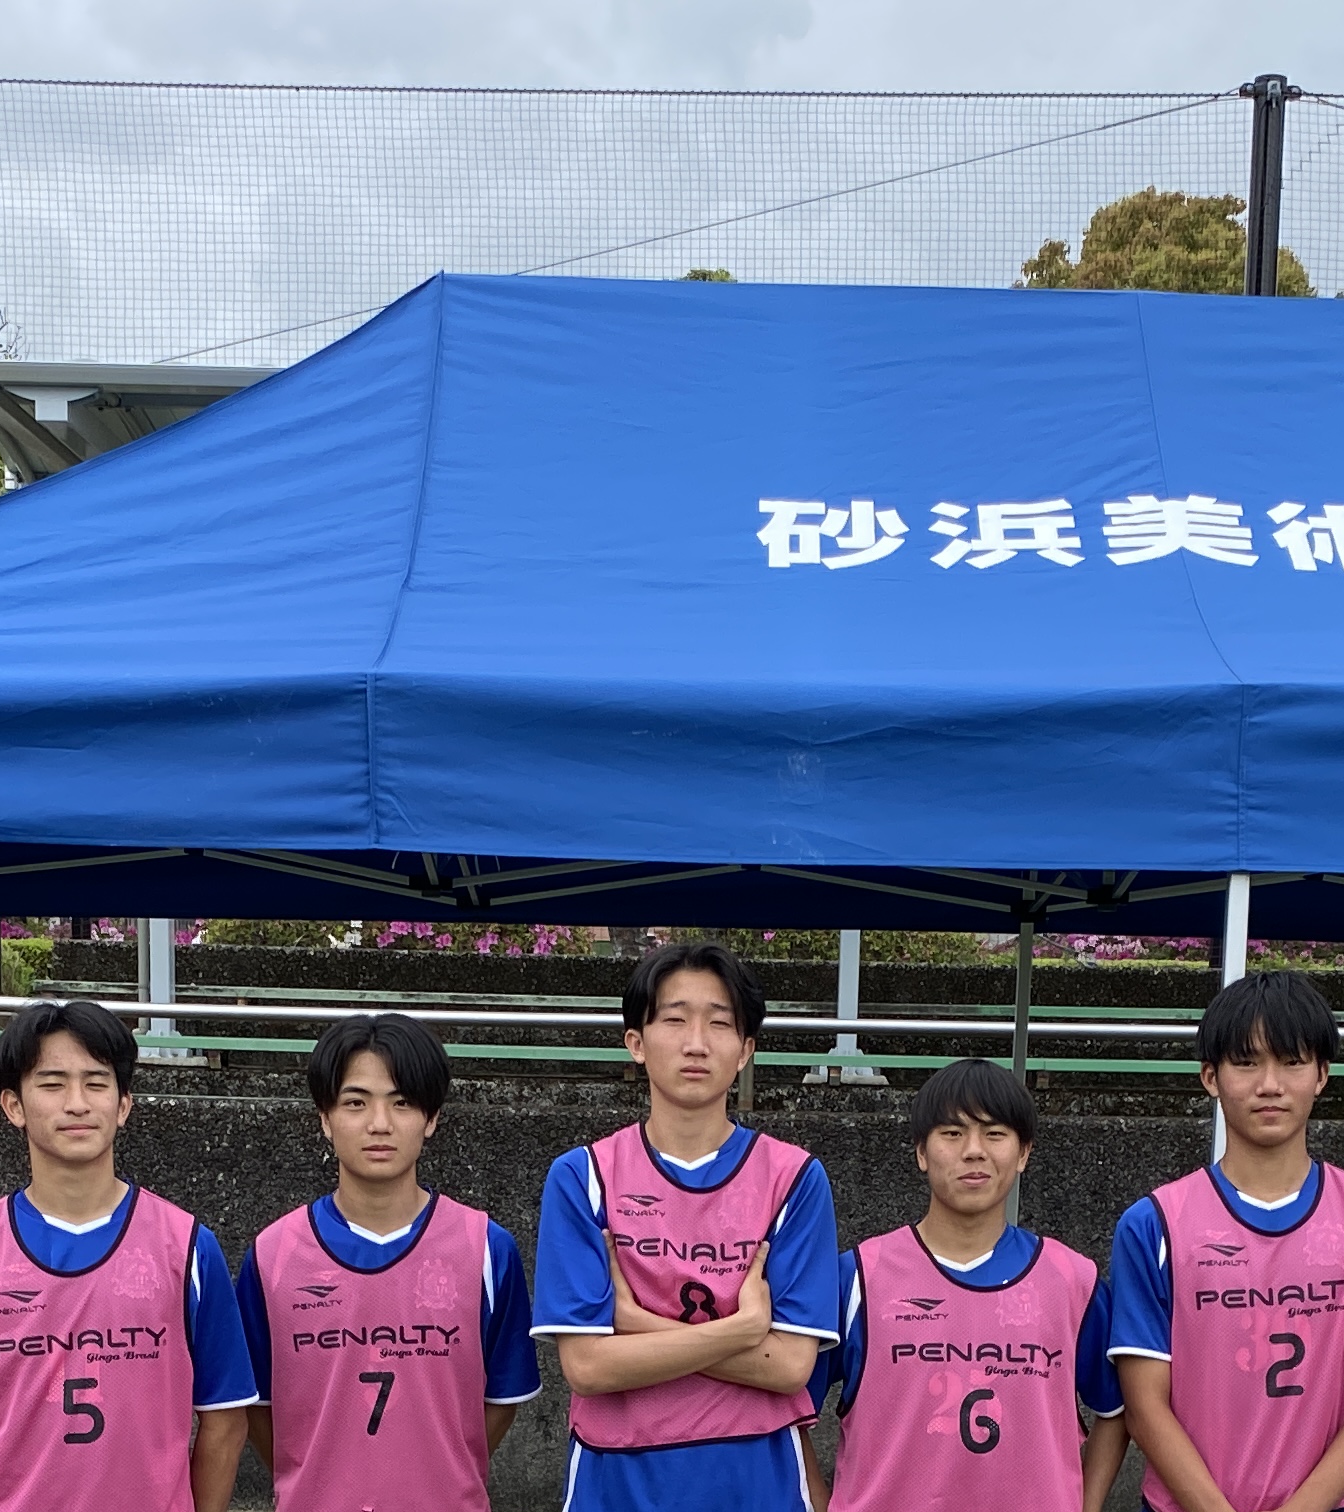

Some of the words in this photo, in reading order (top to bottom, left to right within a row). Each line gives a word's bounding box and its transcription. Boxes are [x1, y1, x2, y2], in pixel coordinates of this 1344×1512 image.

[615, 1208, 666, 1218] PENALTY
[613, 1233, 763, 1262] PENALT
[1197, 1258, 1250, 1268] PENALTY
[292, 1299, 344, 1311] PENALTY
[895, 1313, 950, 1322] PENALTY
[293, 1325, 460, 1353] PENALTY
[891, 1342, 1064, 1368] PENALTY
[1265, 1332, 1306, 1399] 2
[62, 1377, 105, 1445] 5
[358, 1371, 396, 1436] 7
[959, 1388, 1001, 1455] 6
